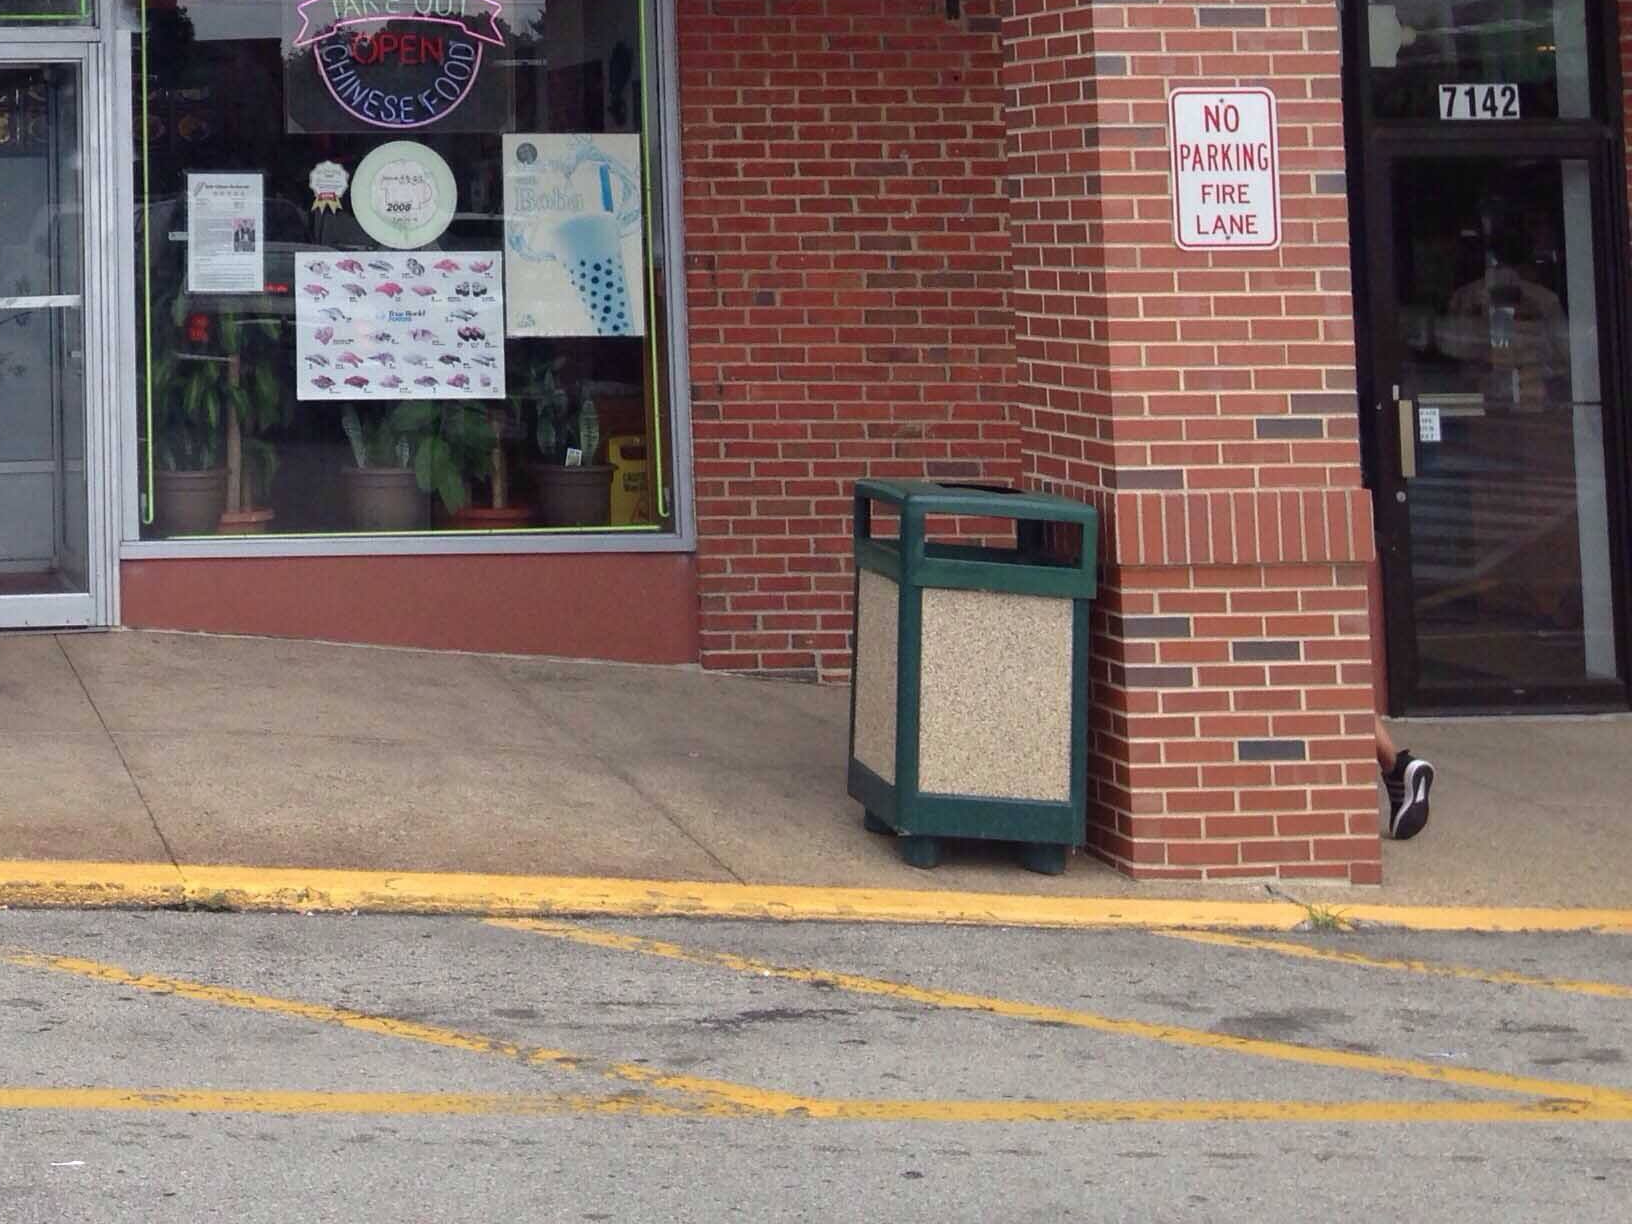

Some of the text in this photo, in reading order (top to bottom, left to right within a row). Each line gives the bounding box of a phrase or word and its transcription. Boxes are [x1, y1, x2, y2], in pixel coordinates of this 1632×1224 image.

[351, 33, 445, 66] OPEN
[320, 41, 477, 124] CHINESE FOOD
[1203, 102, 1241, 134] NO
[1441, 86, 1518, 118] 7142
[1179, 141, 1270, 173] PARKING
[1200, 183, 1251, 206] FIRE
[1195, 213, 1259, 236] LANE
